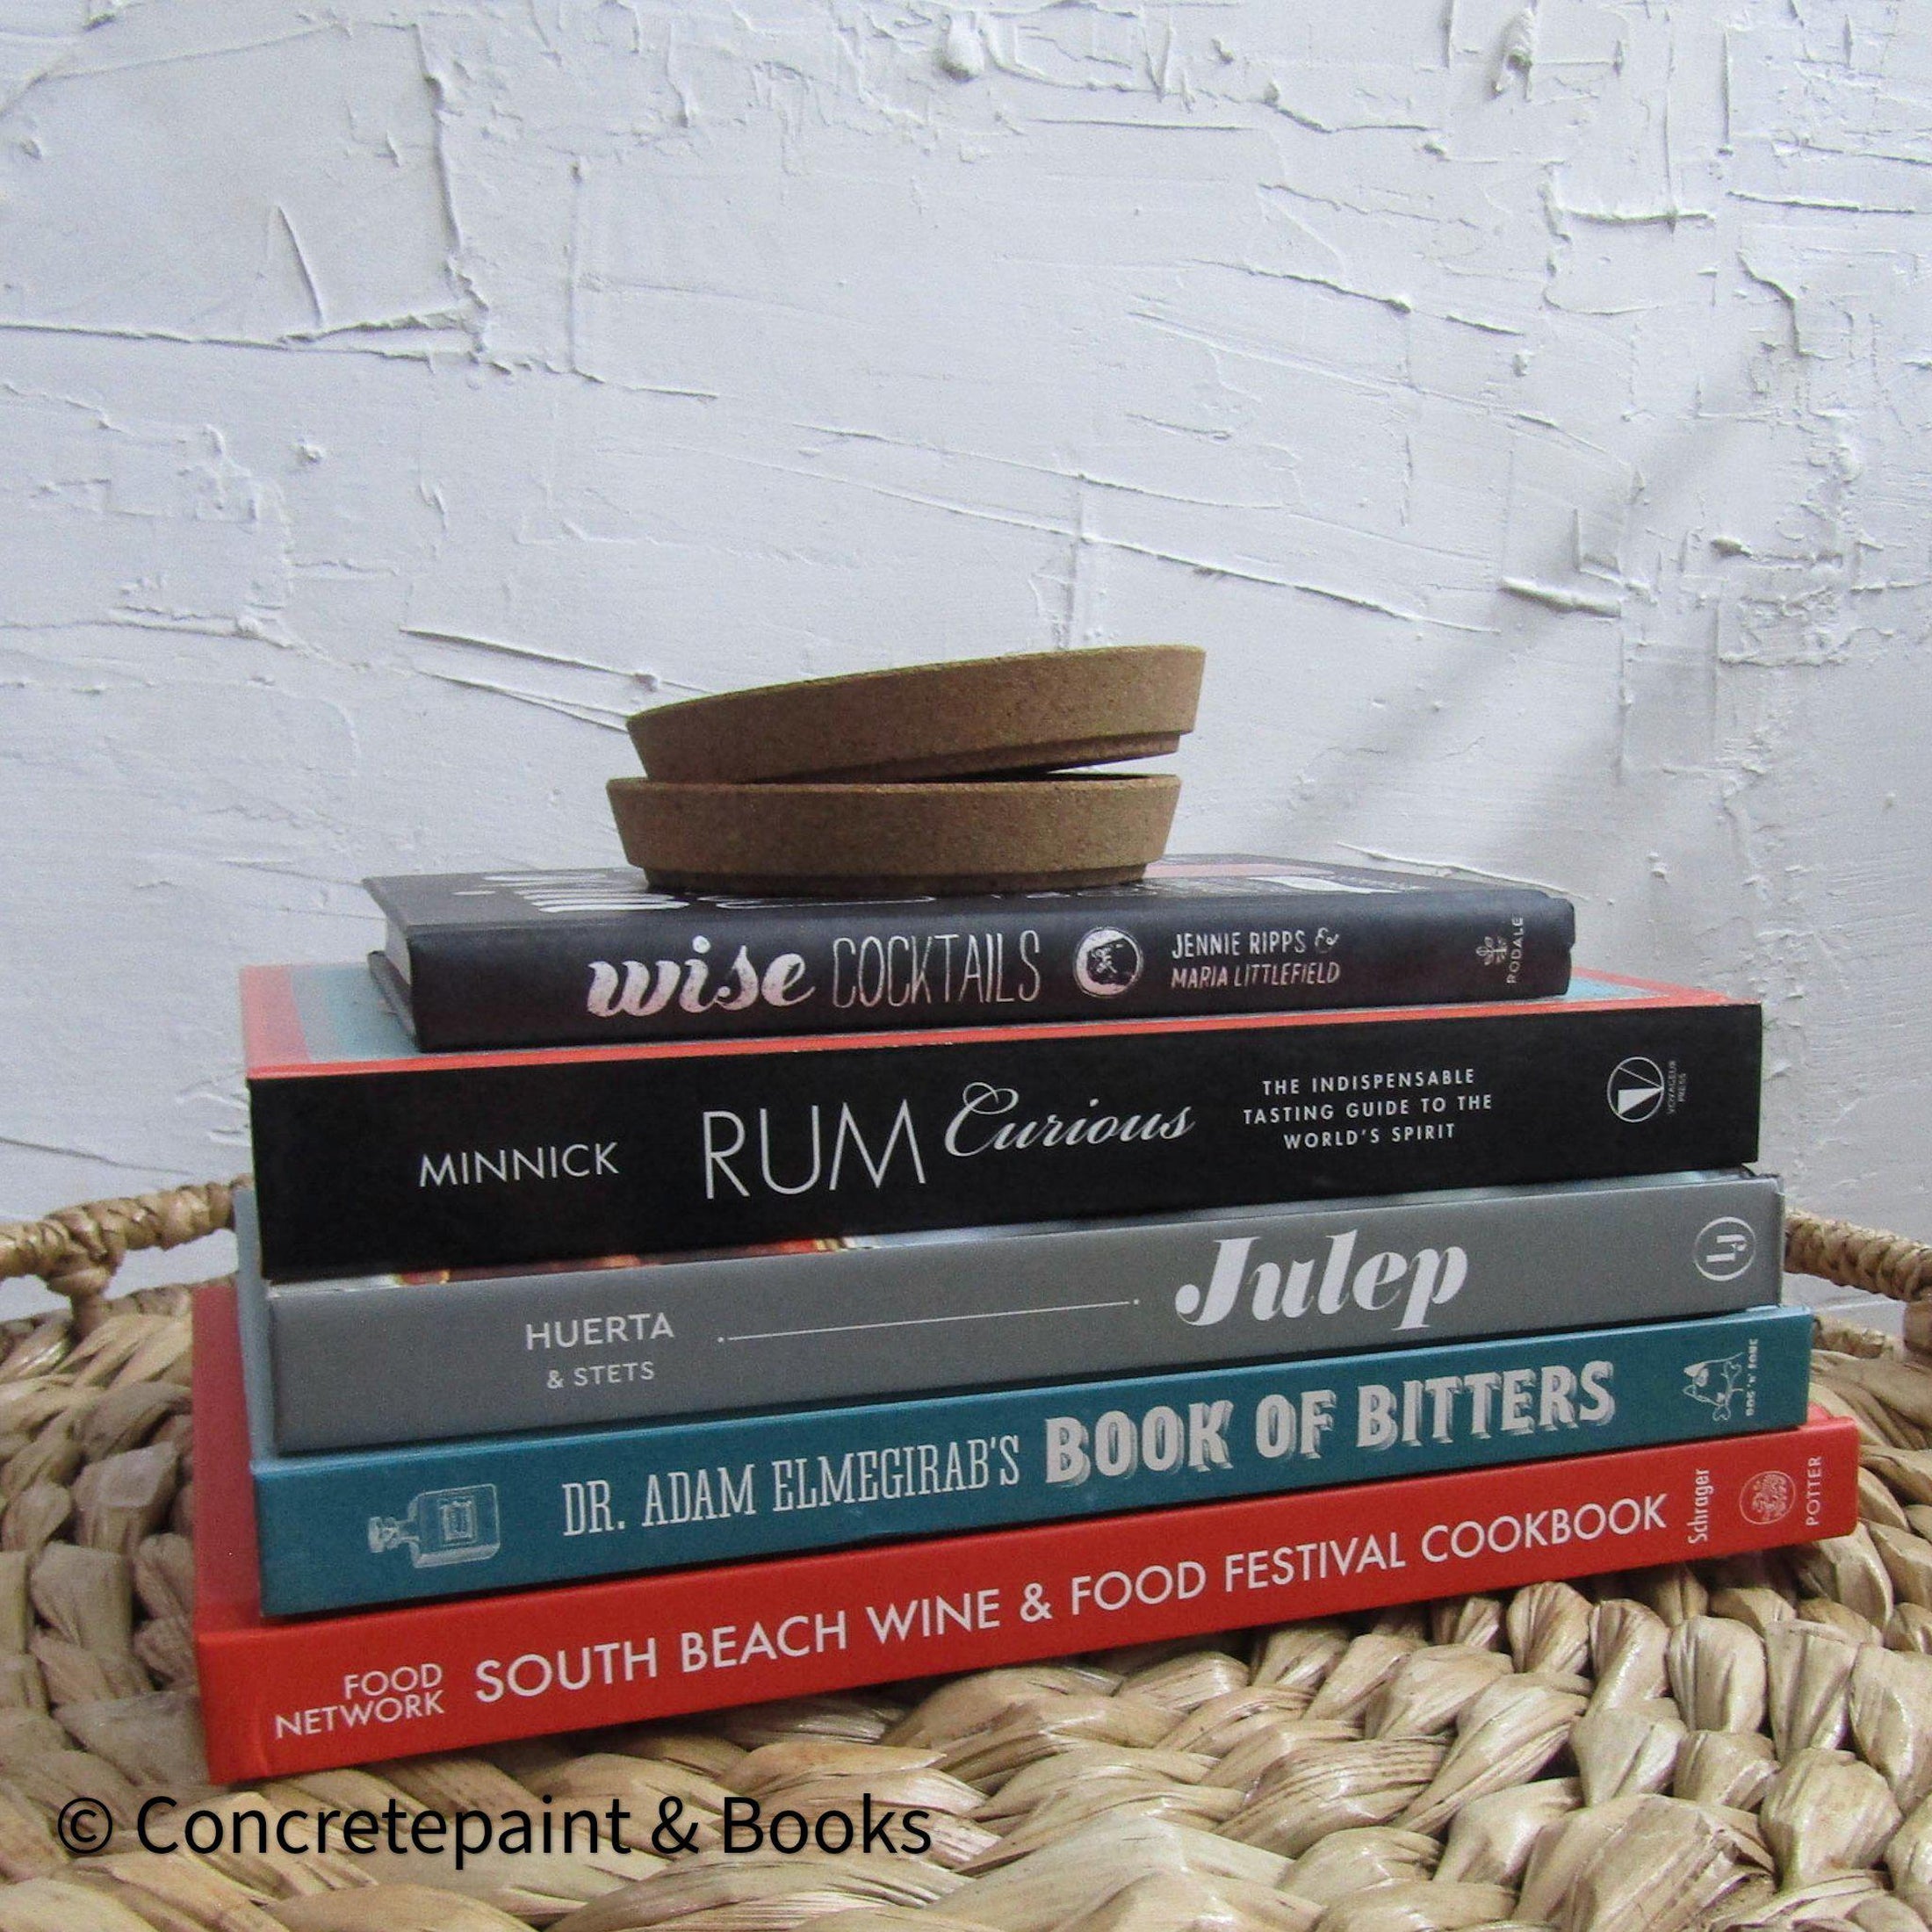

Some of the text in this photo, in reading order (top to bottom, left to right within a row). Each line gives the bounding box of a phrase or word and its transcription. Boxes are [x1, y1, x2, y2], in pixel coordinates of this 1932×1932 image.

[1171, 932, 1241, 959] JENNIE
[1249, 929, 1307, 954] RIPPS
[1506, 915, 1524, 984] RODALE
[588, 930, 1041, 1017] wise COCKTAILS
[1171, 962, 1340, 989] MARIA LITTLEFIELD
[1262, 1068, 1474, 1096] THE INDISPENSABLE
[1244, 1094, 1492, 1125] TASTING GUIDE TO THE
[703, 1082, 1196, 1200] RUM Curious
[1284, 1123, 1455, 1150] WORLD'S SPIRIT
[420, 1142, 619, 1186] MINNICK
[1175, 1229, 1467, 1331] Julep
[526, 1312, 675, 1350] HUERTA
[547, 1361, 655, 1389] & STETS
[562, 1360, 1616, 1537] DR. ADAM ELMEGIRAB'S BOOK OF BITTERS
[1686, 1468, 1715, 1545] Schrager
[1806, 1456, 1822, 1526] POTTER
[475, 1494, 1668, 1703] SOUTH BEACH WINE & FOOD FESTIVAL COOKBOOK
[343, 1663, 443, 1699] FOOD
[275, 1690, 444, 1739] NETWORK
